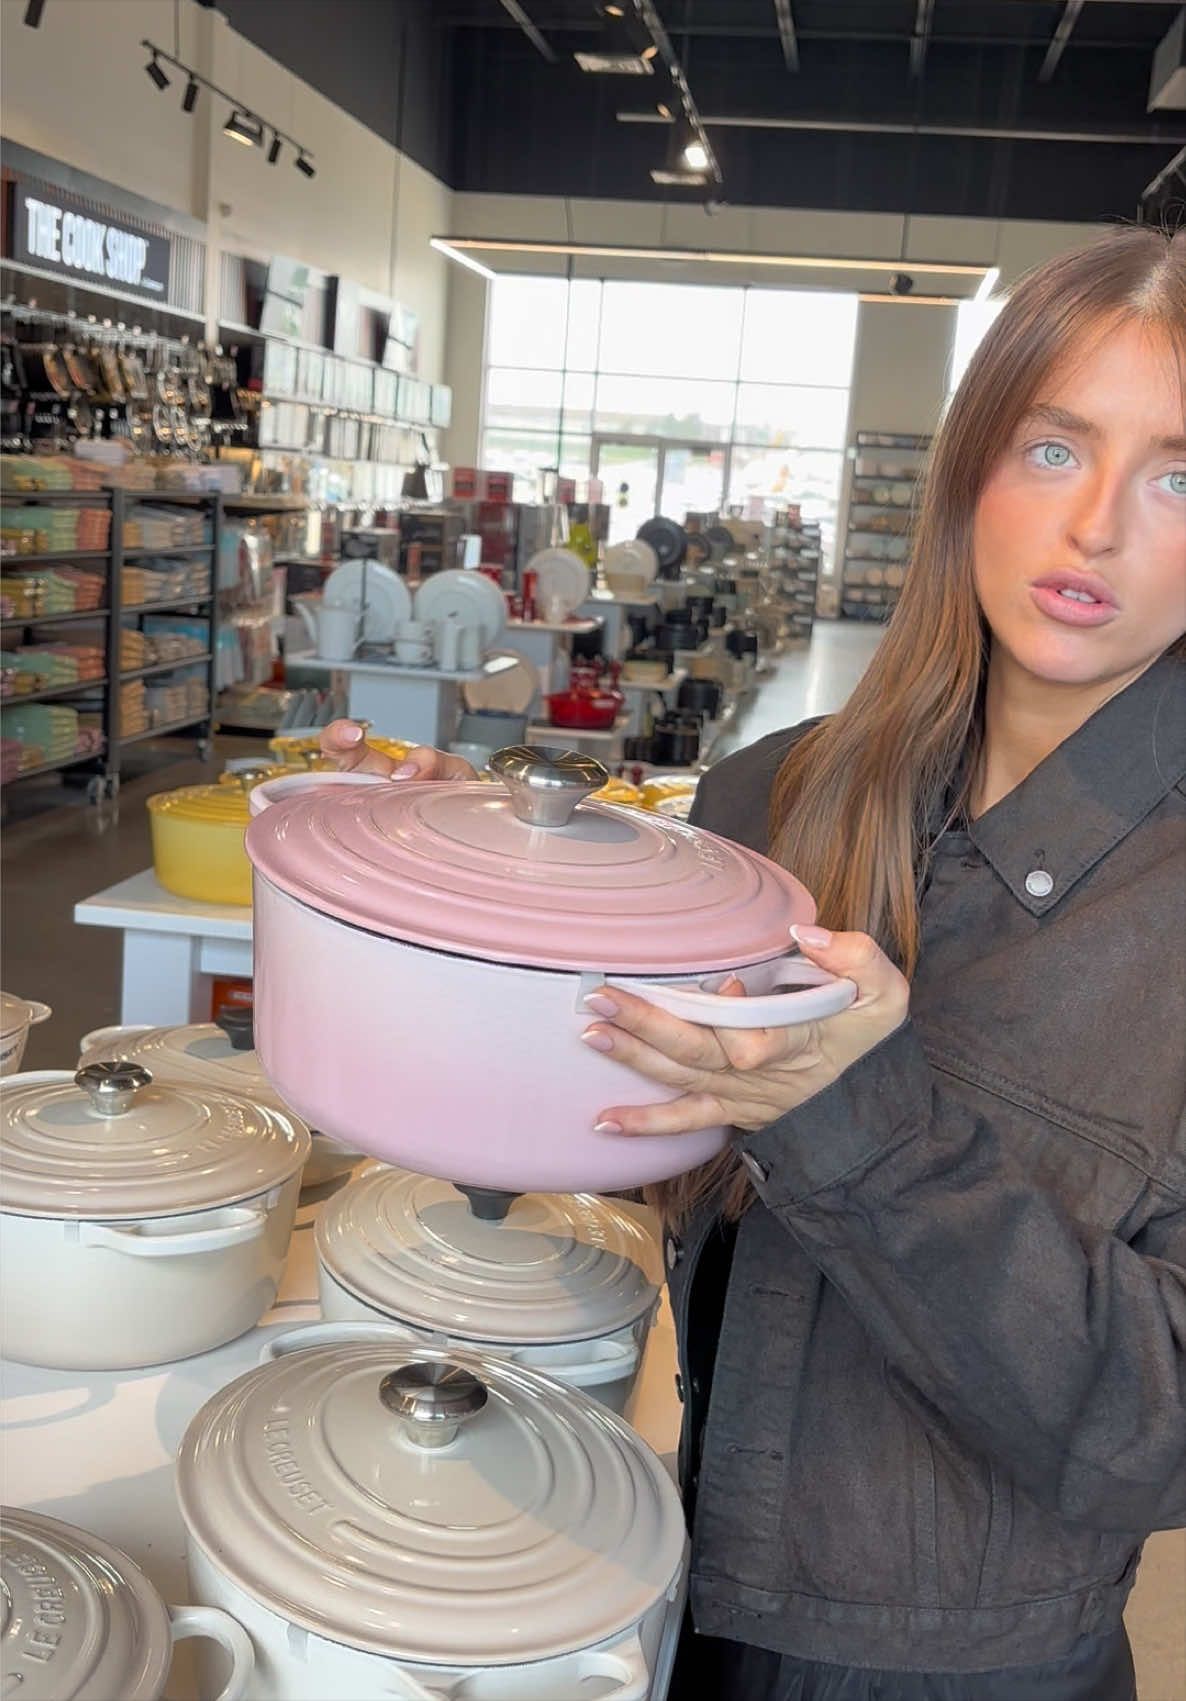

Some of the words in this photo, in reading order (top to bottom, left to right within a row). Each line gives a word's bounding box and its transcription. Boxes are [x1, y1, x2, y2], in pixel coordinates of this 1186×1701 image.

[25, 197, 62, 263] THE
[265, 1440, 336, 1516] CREUSET
[22, 1628, 62, 1664] LE
